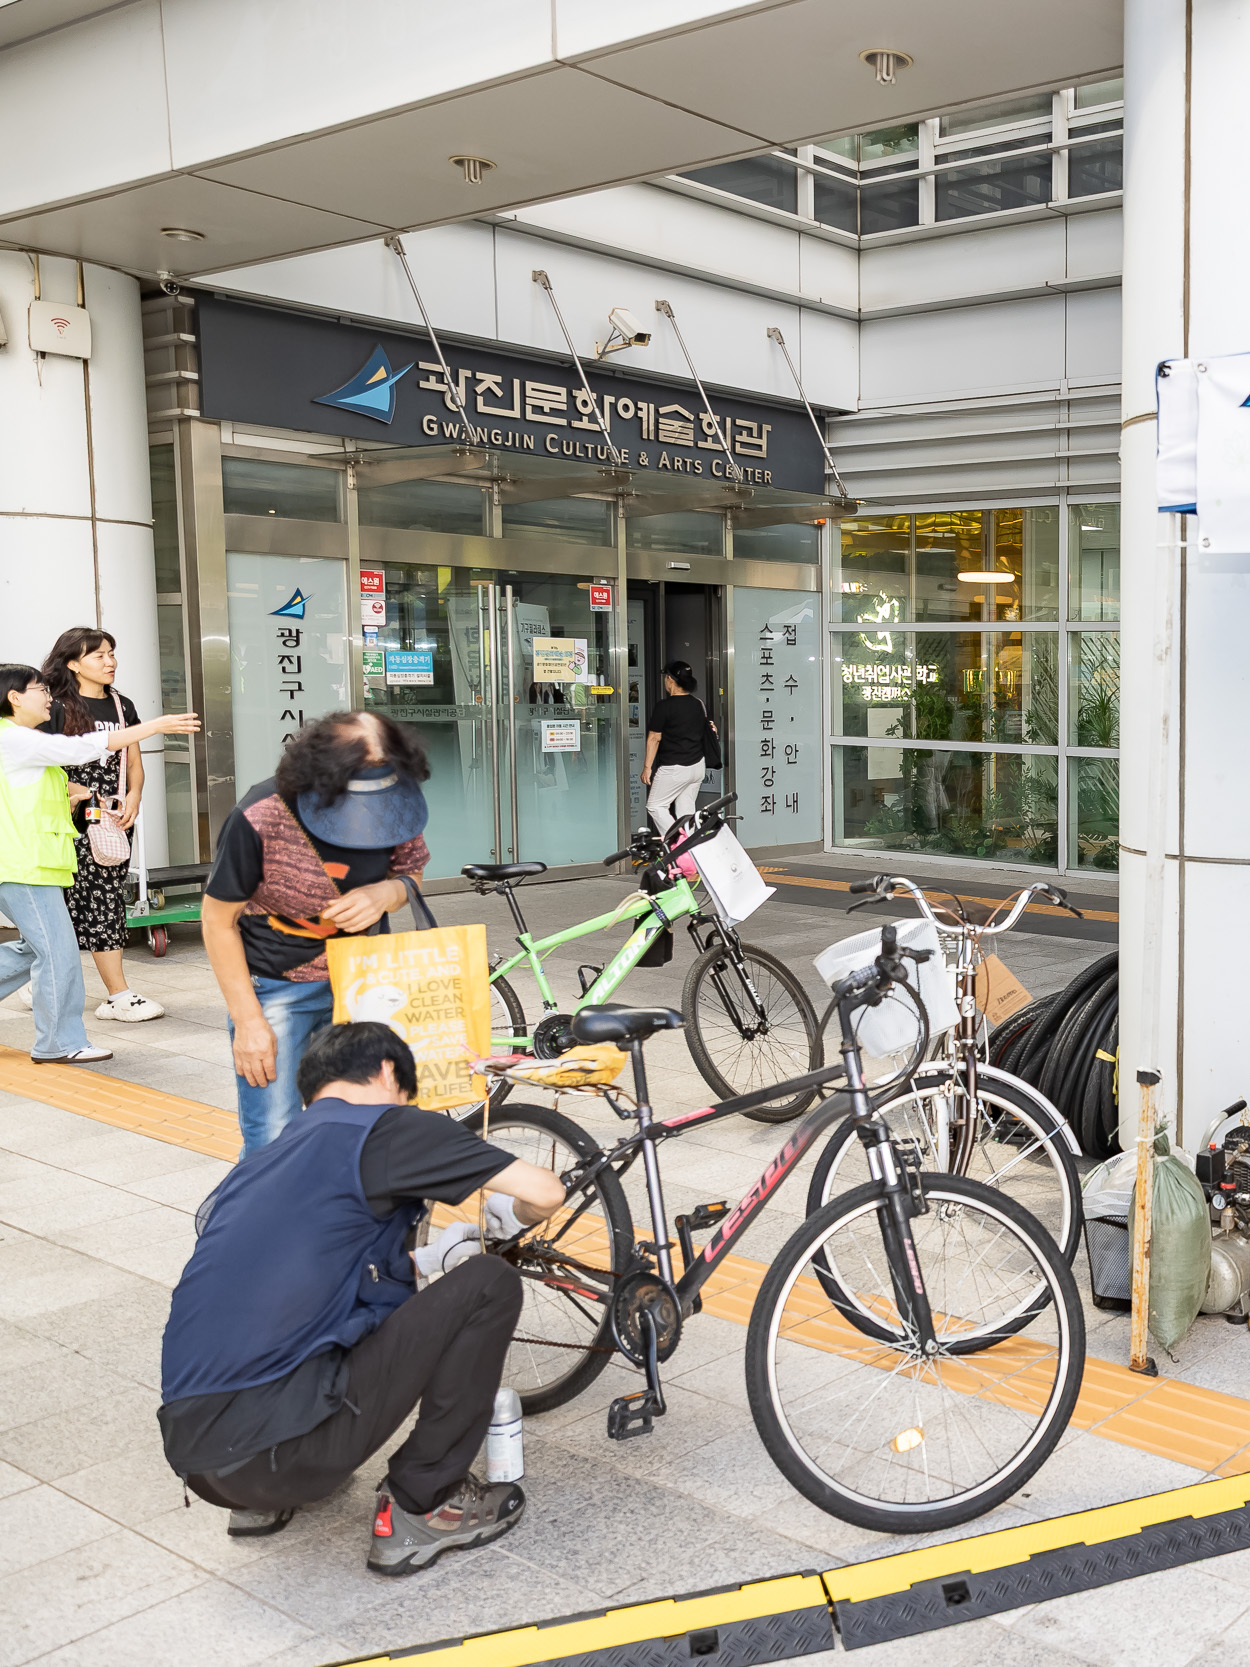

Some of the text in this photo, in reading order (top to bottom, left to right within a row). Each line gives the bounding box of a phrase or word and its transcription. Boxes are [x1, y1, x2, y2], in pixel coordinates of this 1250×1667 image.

[418, 361, 772, 458] 광진문화예술회관
[545, 433, 629, 463] CULTUE
[638, 451, 649, 466] &
[658, 451, 703, 474] ARTS
[370, 665, 383, 673] AED
[387, 946, 460, 968] LITTLE
[426, 964, 461, 979] AND
[418, 978, 462, 994] LOVE
[410, 993, 464, 1009] CLEAN
[404, 1007, 465, 1024] WATER
[410, 1020, 466, 1036] PLEASE
[431, 1033, 467, 1047] SAVE
[417, 1059, 471, 1083] AVE
